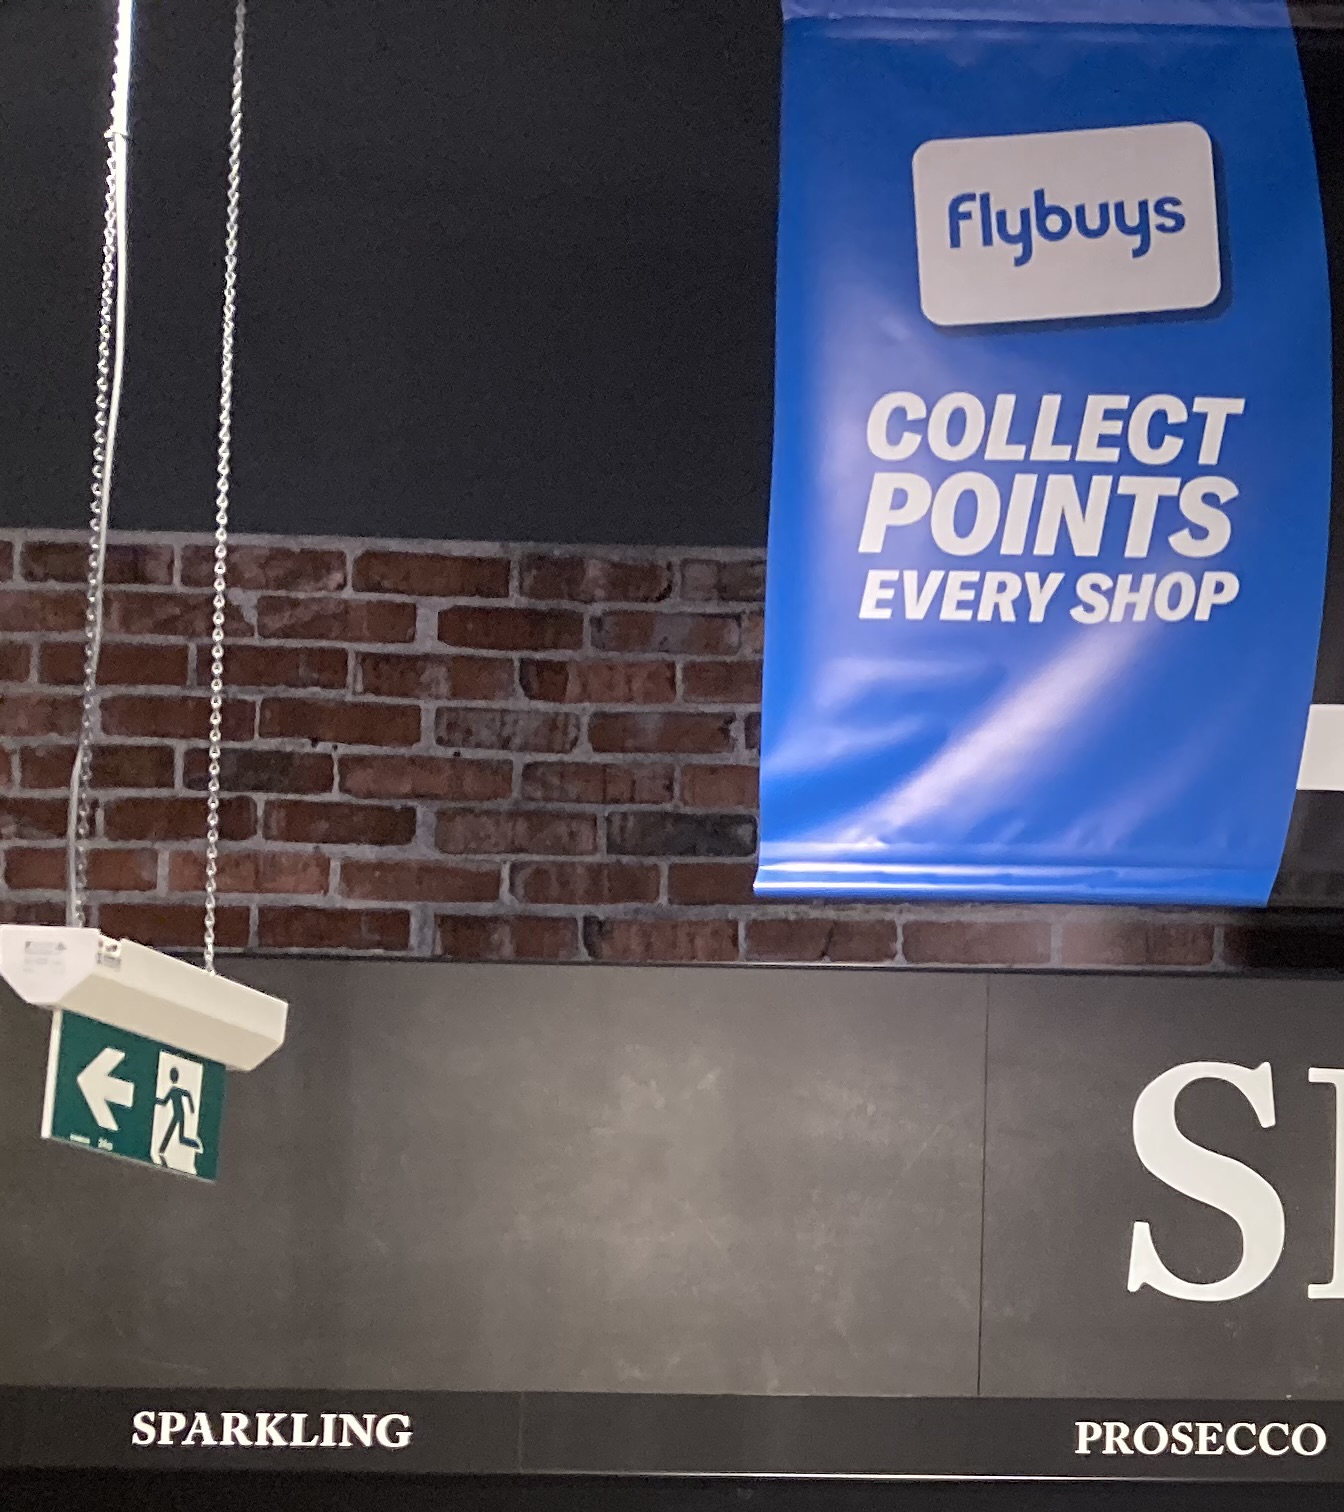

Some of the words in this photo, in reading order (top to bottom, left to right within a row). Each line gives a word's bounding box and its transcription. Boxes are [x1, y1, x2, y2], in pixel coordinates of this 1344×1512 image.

[947, 188, 1187, 267] flybuys
[866, 391, 1246, 465] COLLECT
[857, 471, 1239, 558] POINTS
[858, 569, 1065, 623] EVERY
[1069, 570, 1240, 624] SHOP
[131, 1410, 414, 1449] SPARKLING
[1074, 1420, 1328, 1456] PROSECCO
